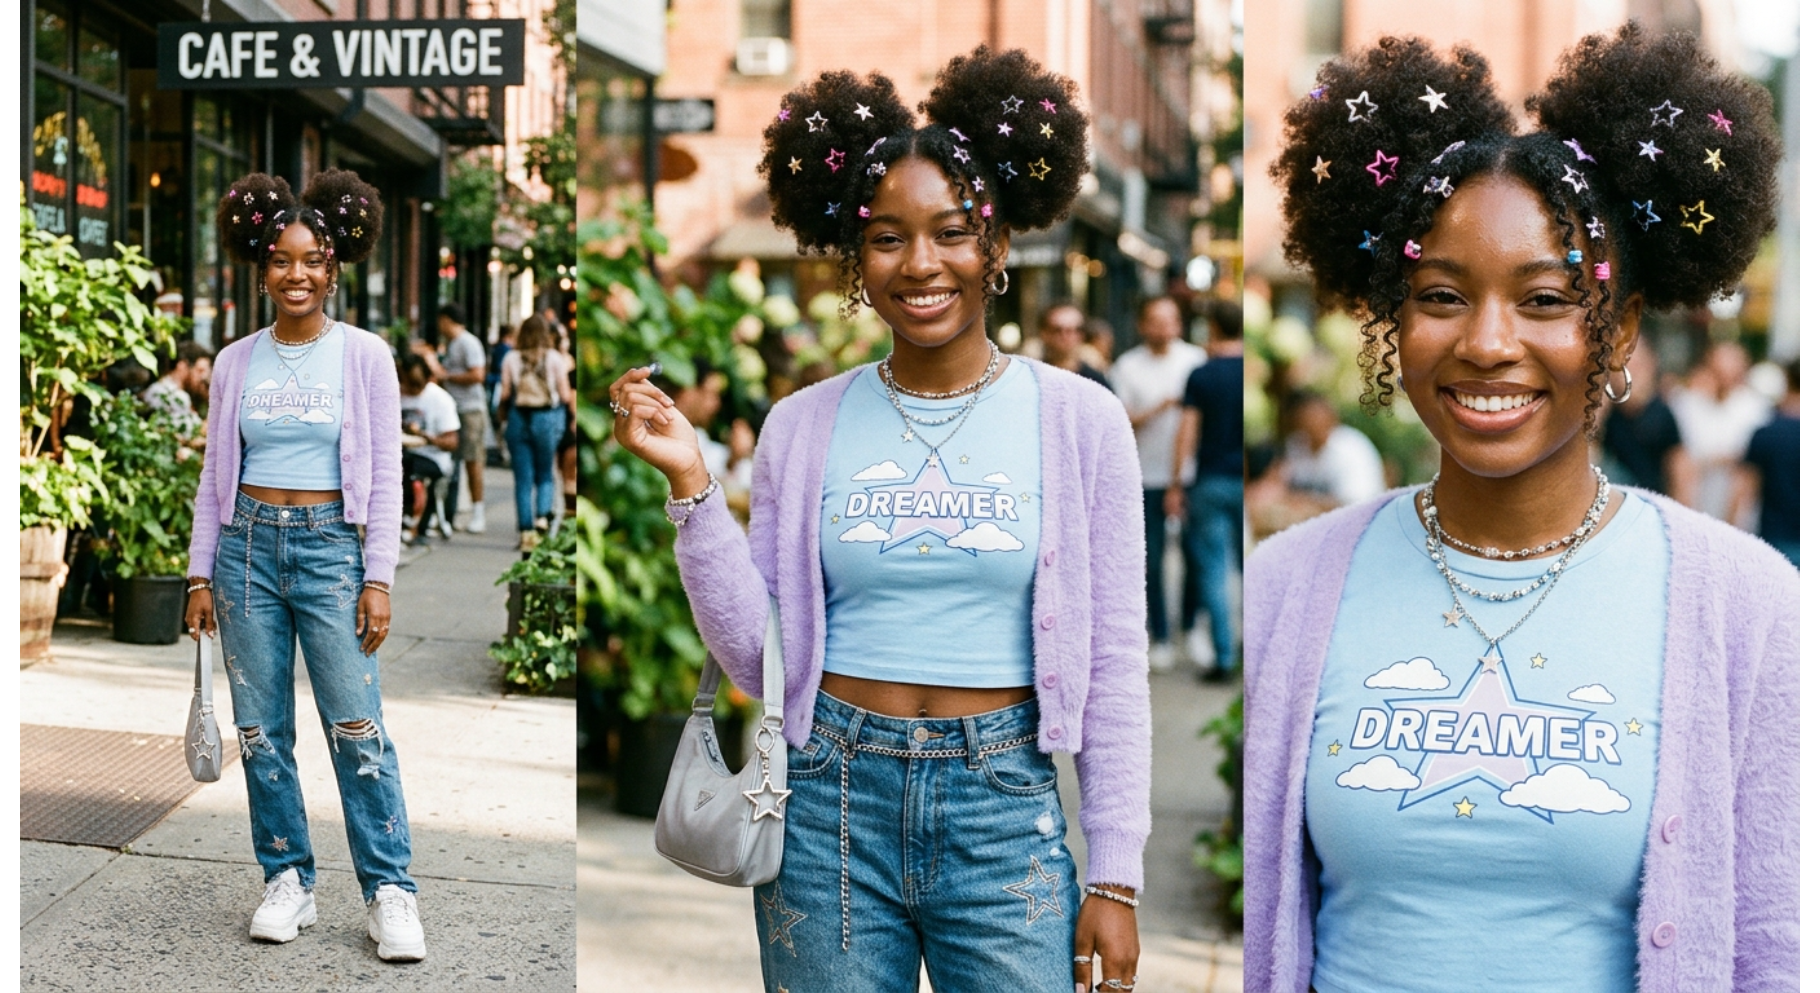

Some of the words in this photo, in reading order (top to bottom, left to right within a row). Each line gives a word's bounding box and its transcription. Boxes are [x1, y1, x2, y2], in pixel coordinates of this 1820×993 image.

[178, 31, 279, 79] CAFE
[290, 34, 320, 78] &
[332, 28, 503, 77] VINTAGE
[845, 491, 1019, 521] DREAMER
[1350, 708, 1621, 765] DREAMER
